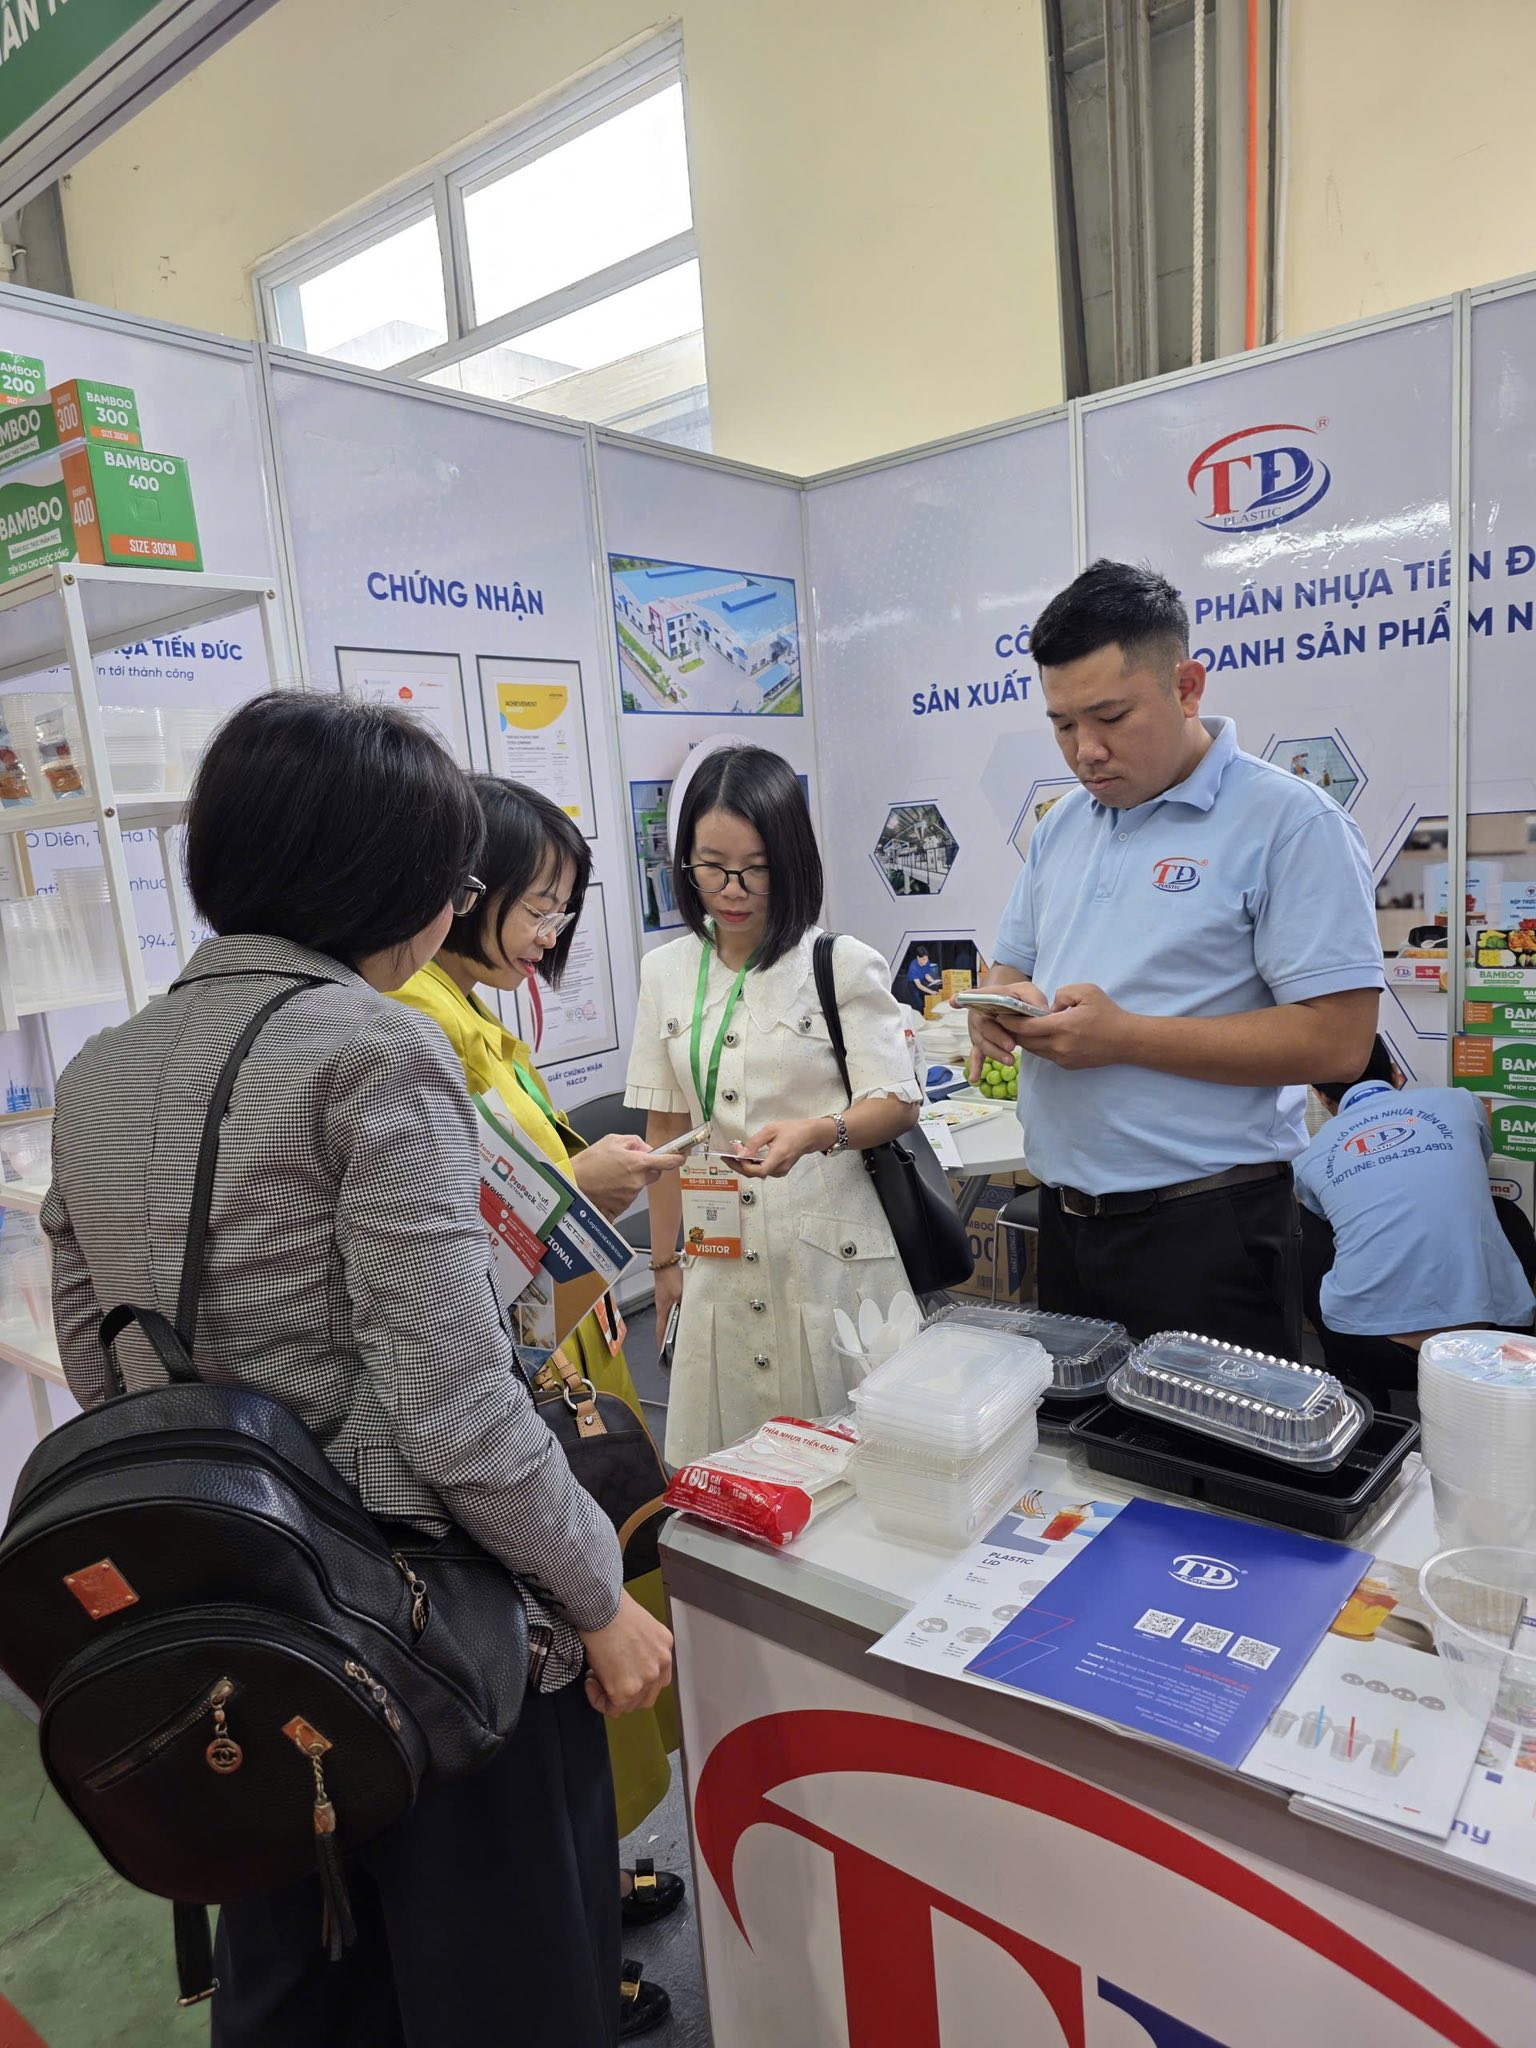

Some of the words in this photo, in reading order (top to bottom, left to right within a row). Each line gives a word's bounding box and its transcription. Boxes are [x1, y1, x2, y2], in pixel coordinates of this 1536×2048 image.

[2, 374, 36, 395] 200
[86, 391, 133, 410] BAMBOO
[0, 408, 41, 448] MBOO
[57, 402, 79, 433] 300
[96, 406, 129, 427] 300
[103, 450, 177, 476] BAMBOO
[128, 473, 160, 492] 400
[0, 496, 63, 542] BAMBOO
[73, 496, 96, 528] 400
[1223, 506, 1283, 527] PLASTIC
[129, 538, 151, 554] SIZE
[151, 540, 178, 557] 30CM
[367, 570, 469, 608] CHỨNG
[474, 581, 545, 622] NHẬN
[995, 623, 1032, 658] CÔ
[1294, 567, 1394, 610] NHỰA
[151, 634, 197, 659] TIẾN
[201, 639, 244, 661] ĐỨC
[104, 665, 126, 677] tới
[128, 665, 164, 679] thành
[165, 668, 195, 682] công
[912, 683, 960, 716] SẢN
[967, 669, 1032, 708] XUẤT
[1192, 636, 1285, 673] OANH
[1296, 620, 1362, 662] SẢN
[1479, 970, 1525, 979] BAMBOO
[1331, 1159, 1376, 1188] HOTLINE:
[1378, 1141, 1454, 1166] 094.292.4903
[510, 1174, 537, 1205] ProPack
[966, 1220, 995, 1232] MBOO
[695, 1244, 730, 1255] VISITOR
[761, 1426, 779, 1436] THÌA
[802, 1438, 819, 1449] TIẾN
[819, 1443, 839, 1454] ĐỨC
[681, 1466, 709, 1489] 100
[982, 1558, 1001, 1566] LID
[988, 1551, 1034, 1566] PLASTIC
